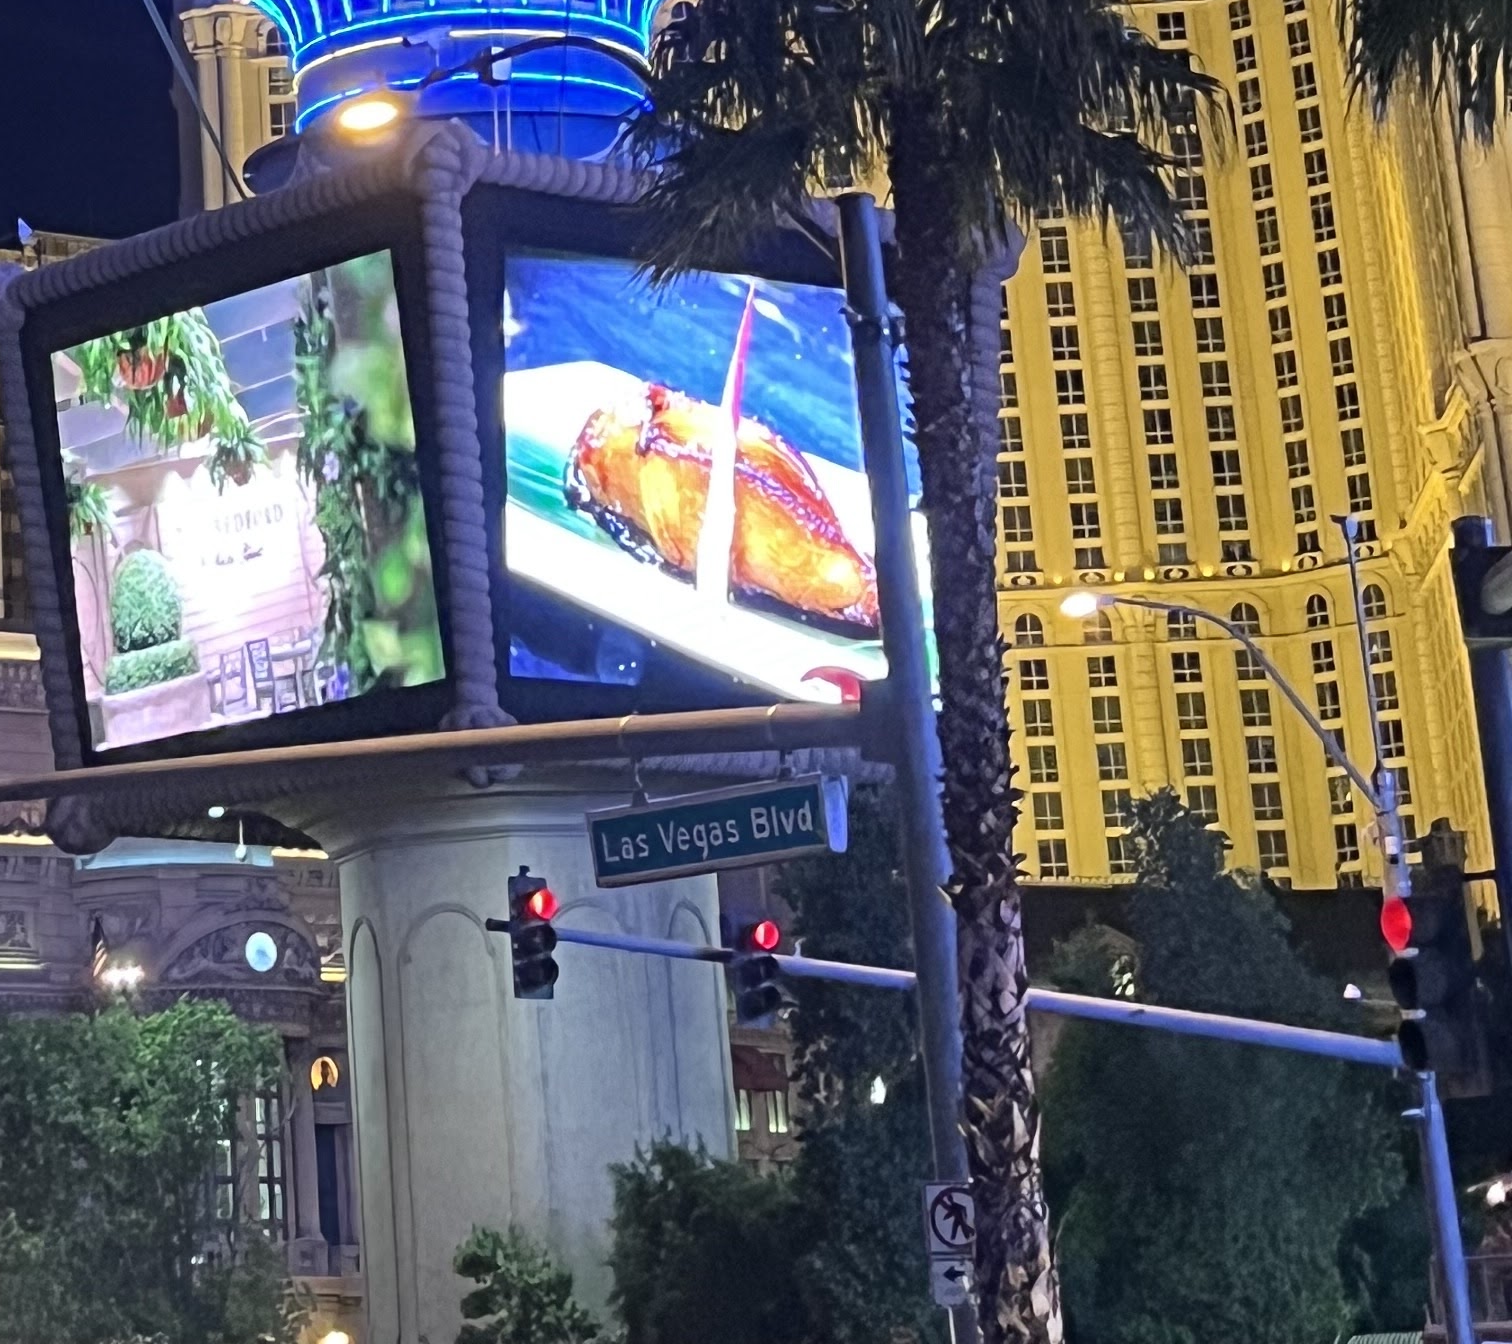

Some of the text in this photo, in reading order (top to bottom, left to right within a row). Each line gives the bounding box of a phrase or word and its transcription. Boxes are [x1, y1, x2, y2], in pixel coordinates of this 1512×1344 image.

[601, 800, 813, 862] Las Vegas Blvd
